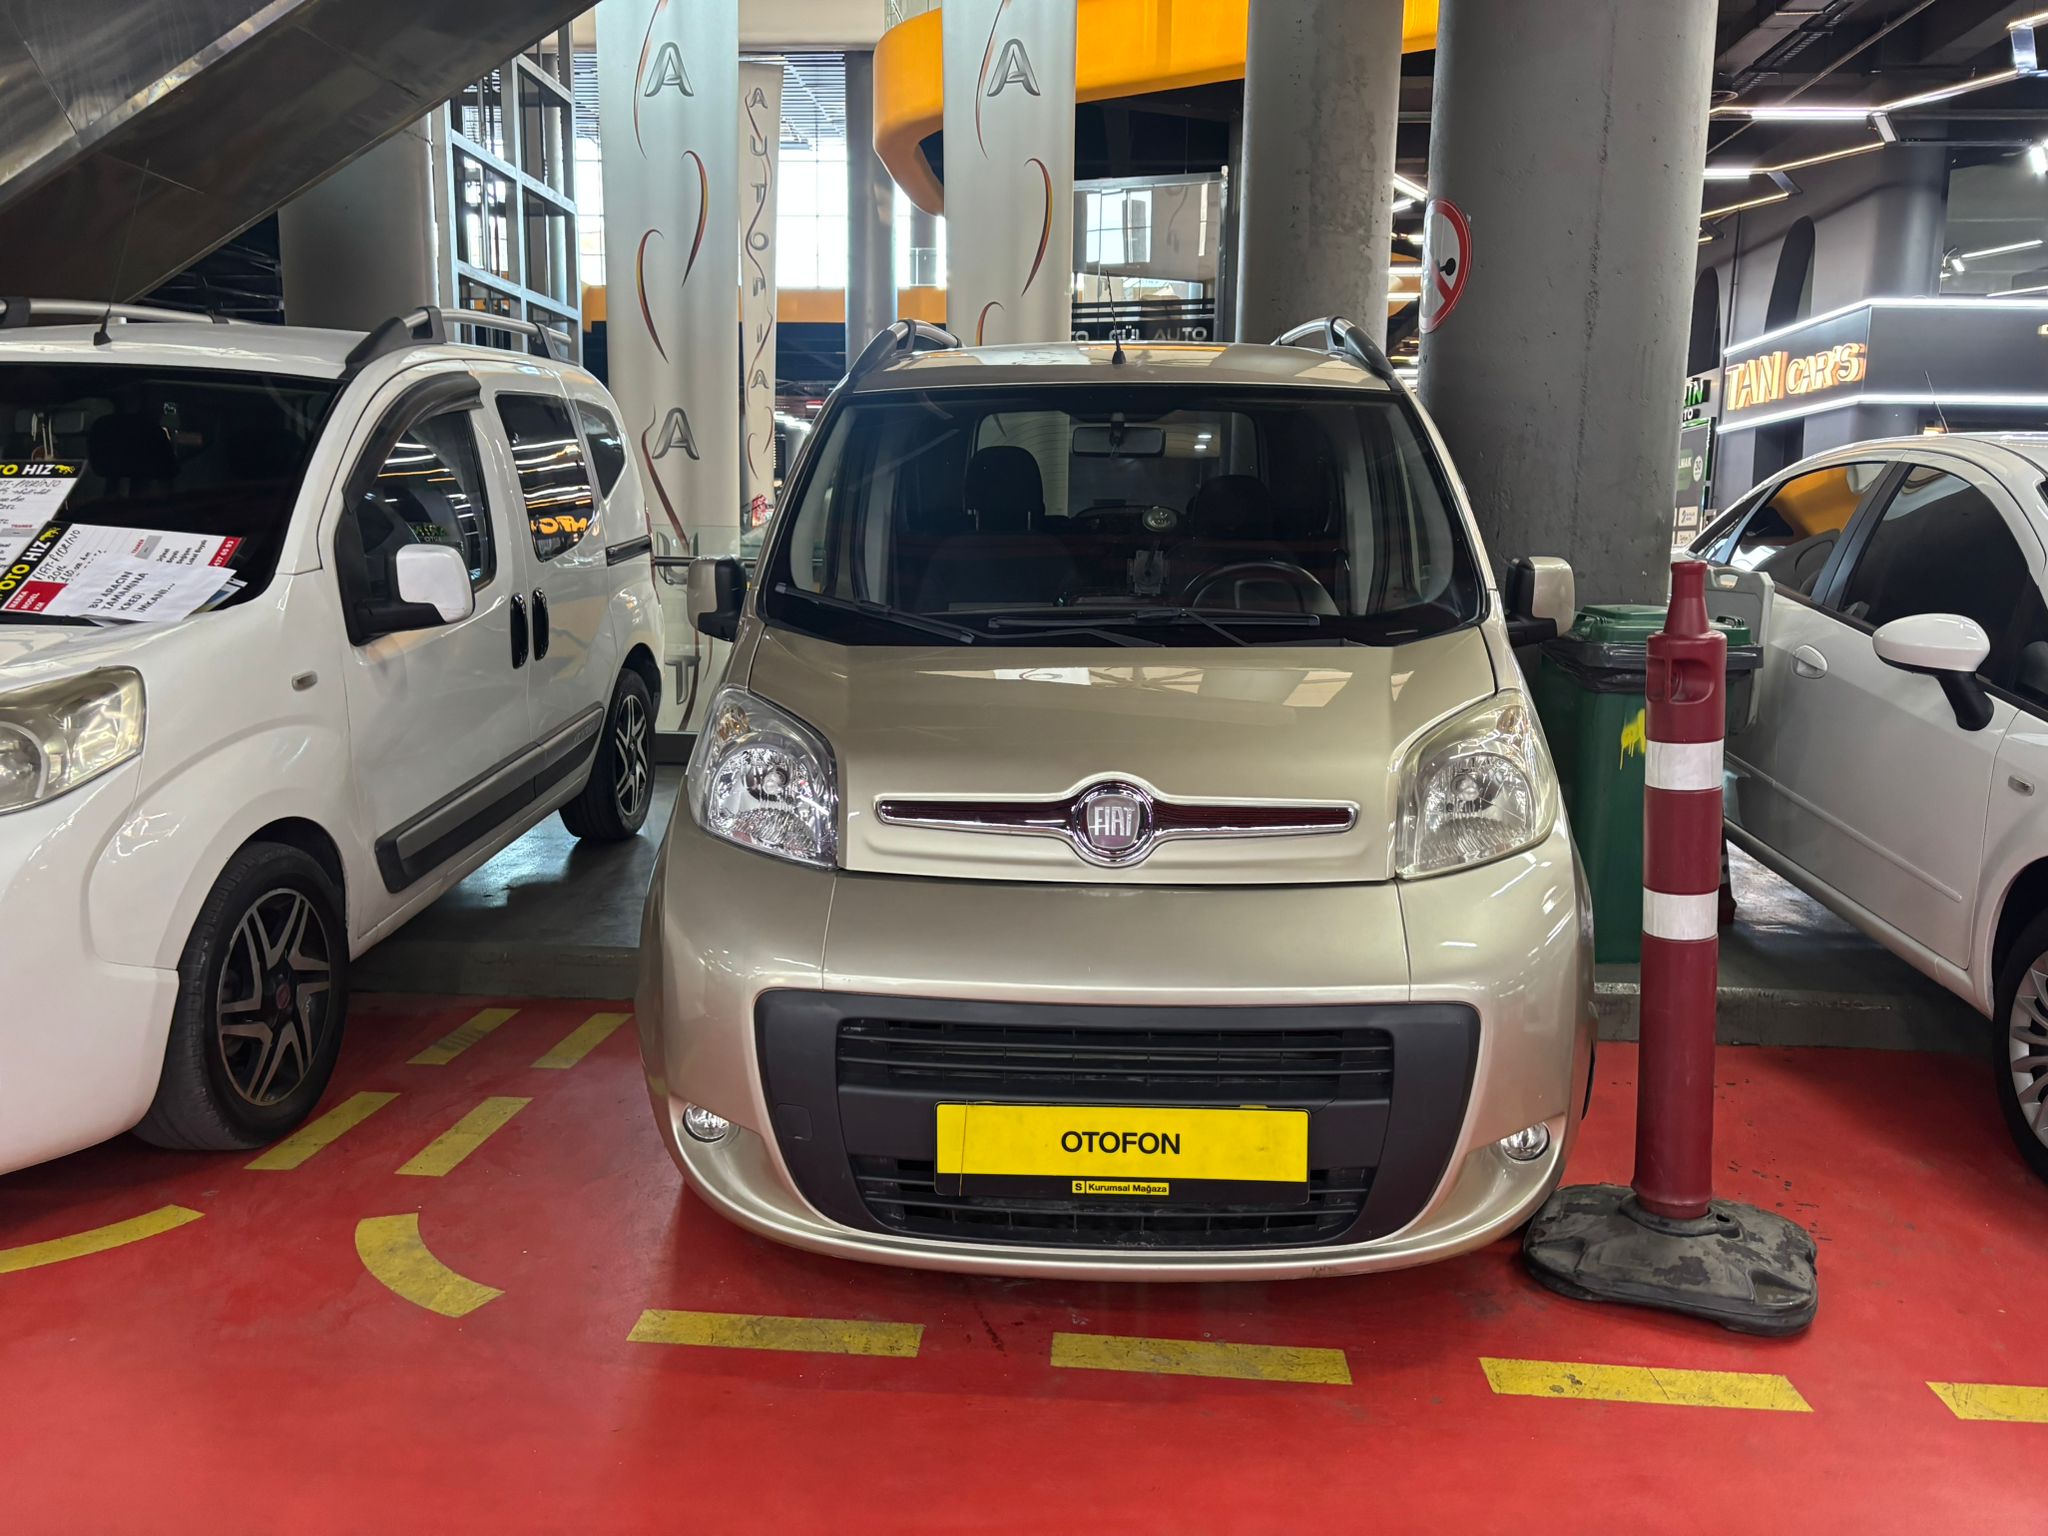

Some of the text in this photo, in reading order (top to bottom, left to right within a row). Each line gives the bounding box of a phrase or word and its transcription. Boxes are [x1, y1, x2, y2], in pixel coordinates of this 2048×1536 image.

[644, 41, 694, 98] A
[987, 39, 1041, 98] A
[1154, 326, 1207, 341] AUTO
[1725, 342, 1866, 411] TAN CAR'S
[21, 464, 56, 475] HIZ
[0, 541, 52, 590] OTO HIZ
[9, 590, 29, 609] MARKA
[20, 592, 41, 610] MODEL
[88, 570, 133, 609] BU ARACIN
[101, 572, 149, 610] TAMAMINA
[32, 601, 46, 611] KM
[1094, 805, 1136, 837] FIAT
[1061, 1131, 1181, 1154] OTOFON
[1088, 1183, 1131, 1193] Kurumsal
[1132, 1184, 1168, 1194] Mağaza
